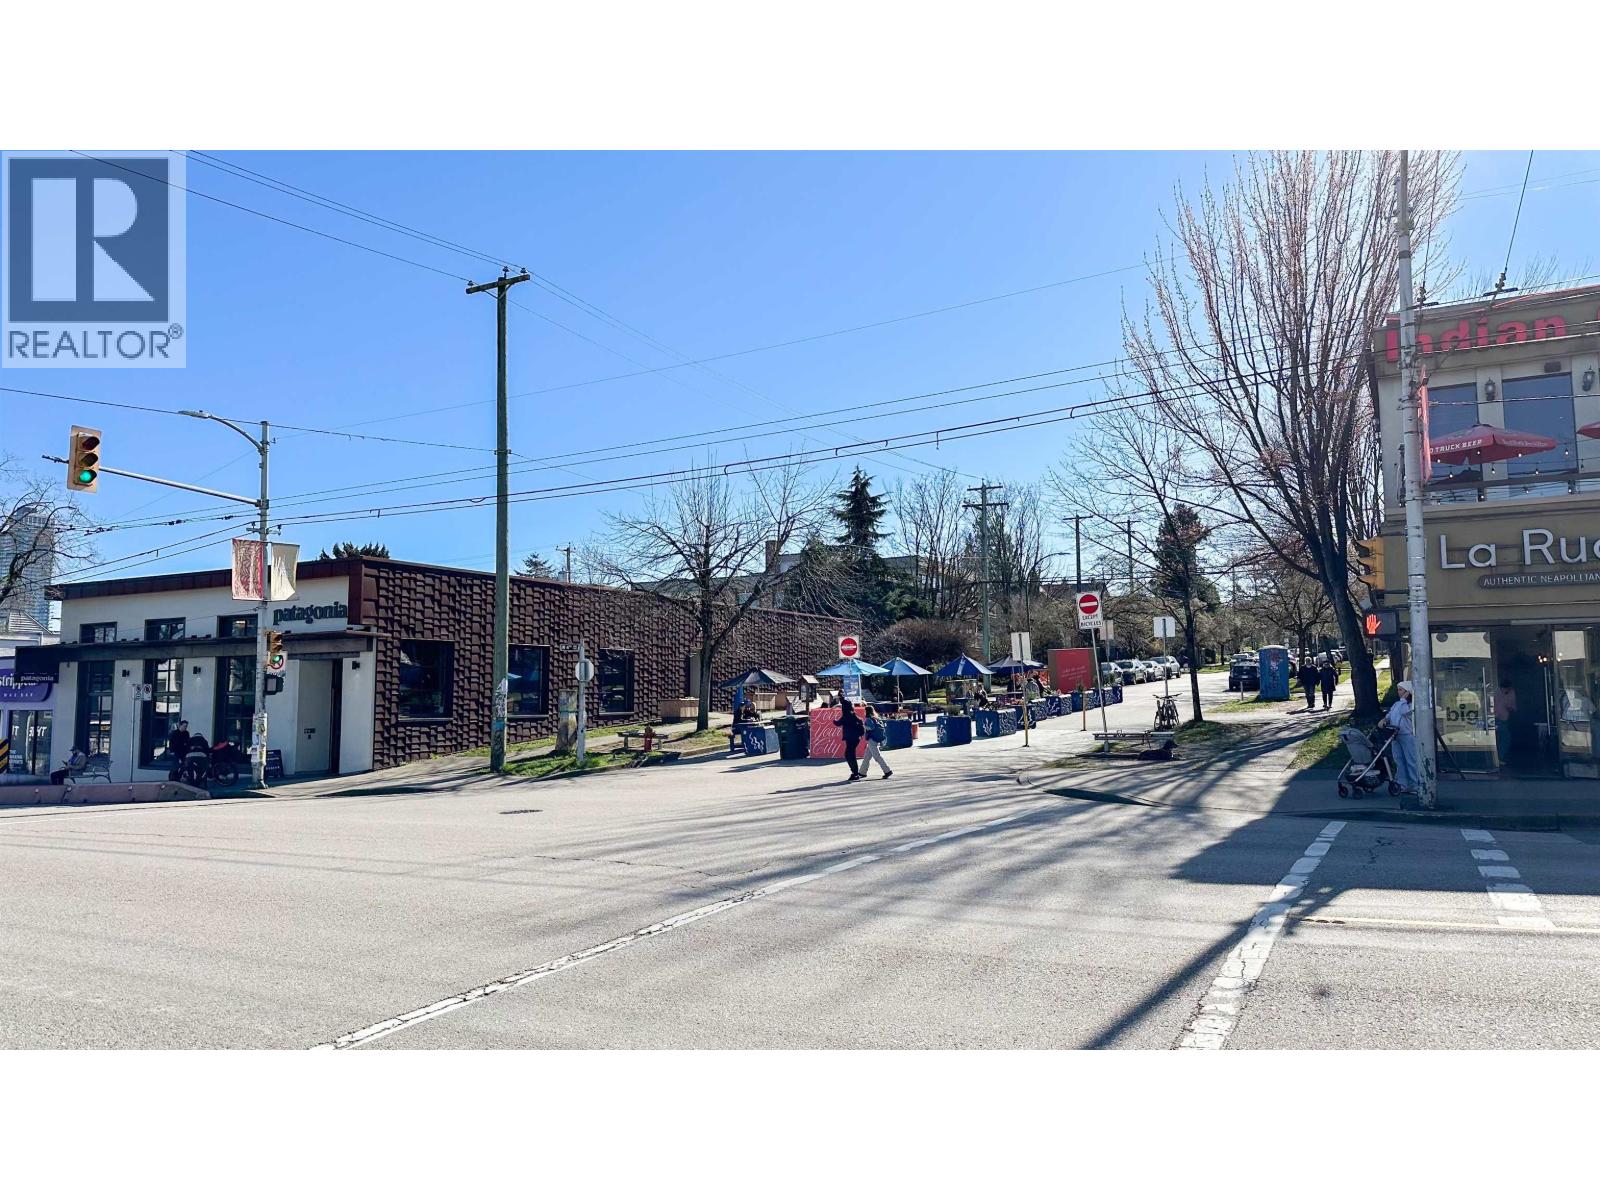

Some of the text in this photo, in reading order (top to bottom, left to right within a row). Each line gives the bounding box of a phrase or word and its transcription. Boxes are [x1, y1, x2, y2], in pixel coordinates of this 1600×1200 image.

[1386, 315, 1567, 362] Indian
[1434, 443, 1461, 453] TRUCK
[1462, 439, 1482, 447] BEER
[1440, 528, 1600, 569] La Ru
[1484, 574, 1537, 586] AUTHENTIC
[273, 601, 348, 626] patagonia
[814, 709, 842, 724] Love
[814, 723, 842, 744] Your
[812, 738, 841, 758] City
